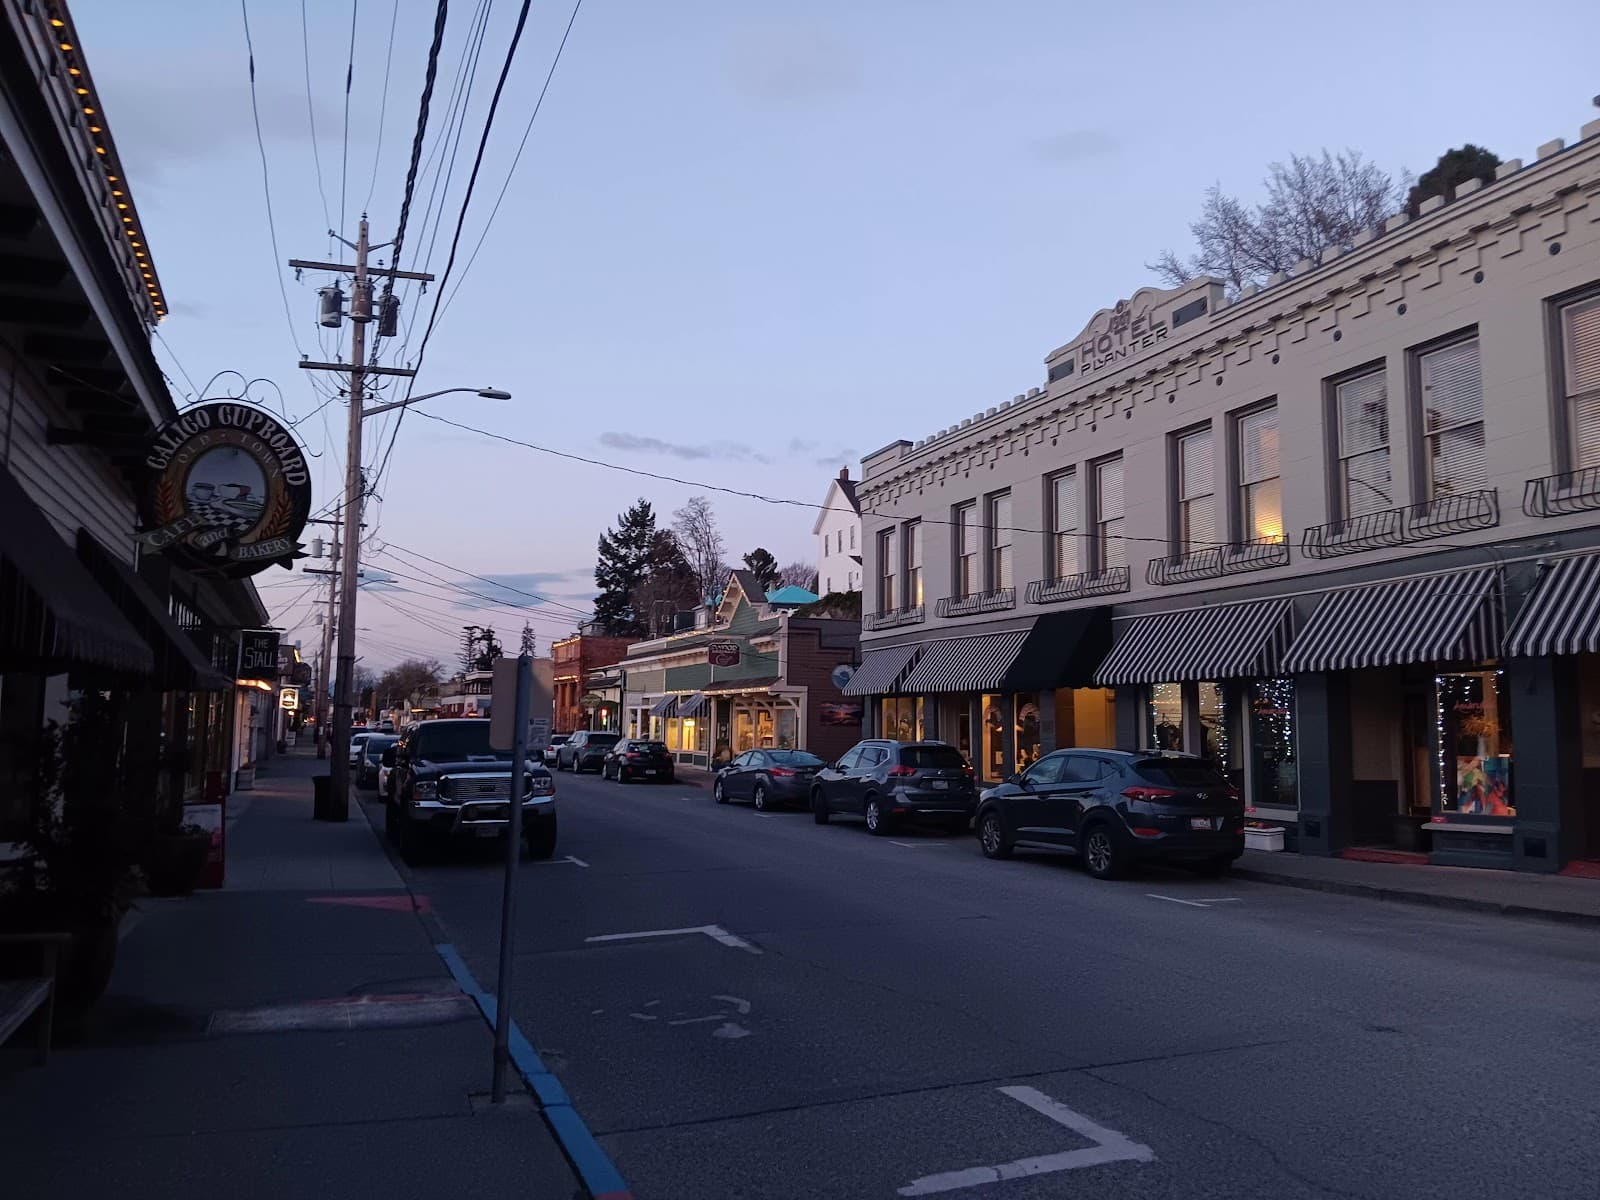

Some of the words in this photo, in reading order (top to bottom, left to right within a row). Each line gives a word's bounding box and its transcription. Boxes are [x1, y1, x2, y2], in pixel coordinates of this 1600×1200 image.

[1080, 311, 1165, 363] HOTEL
[1081, 327, 1168, 375] PLANTER
[145, 408, 211, 471] CALICO
[217, 405, 308, 487] CUPBOARD
[198, 527, 229, 548] and
[238, 535, 292, 559] BAKERY
[244, 647, 275, 670] STALL
[254, 638, 270, 649] THE
